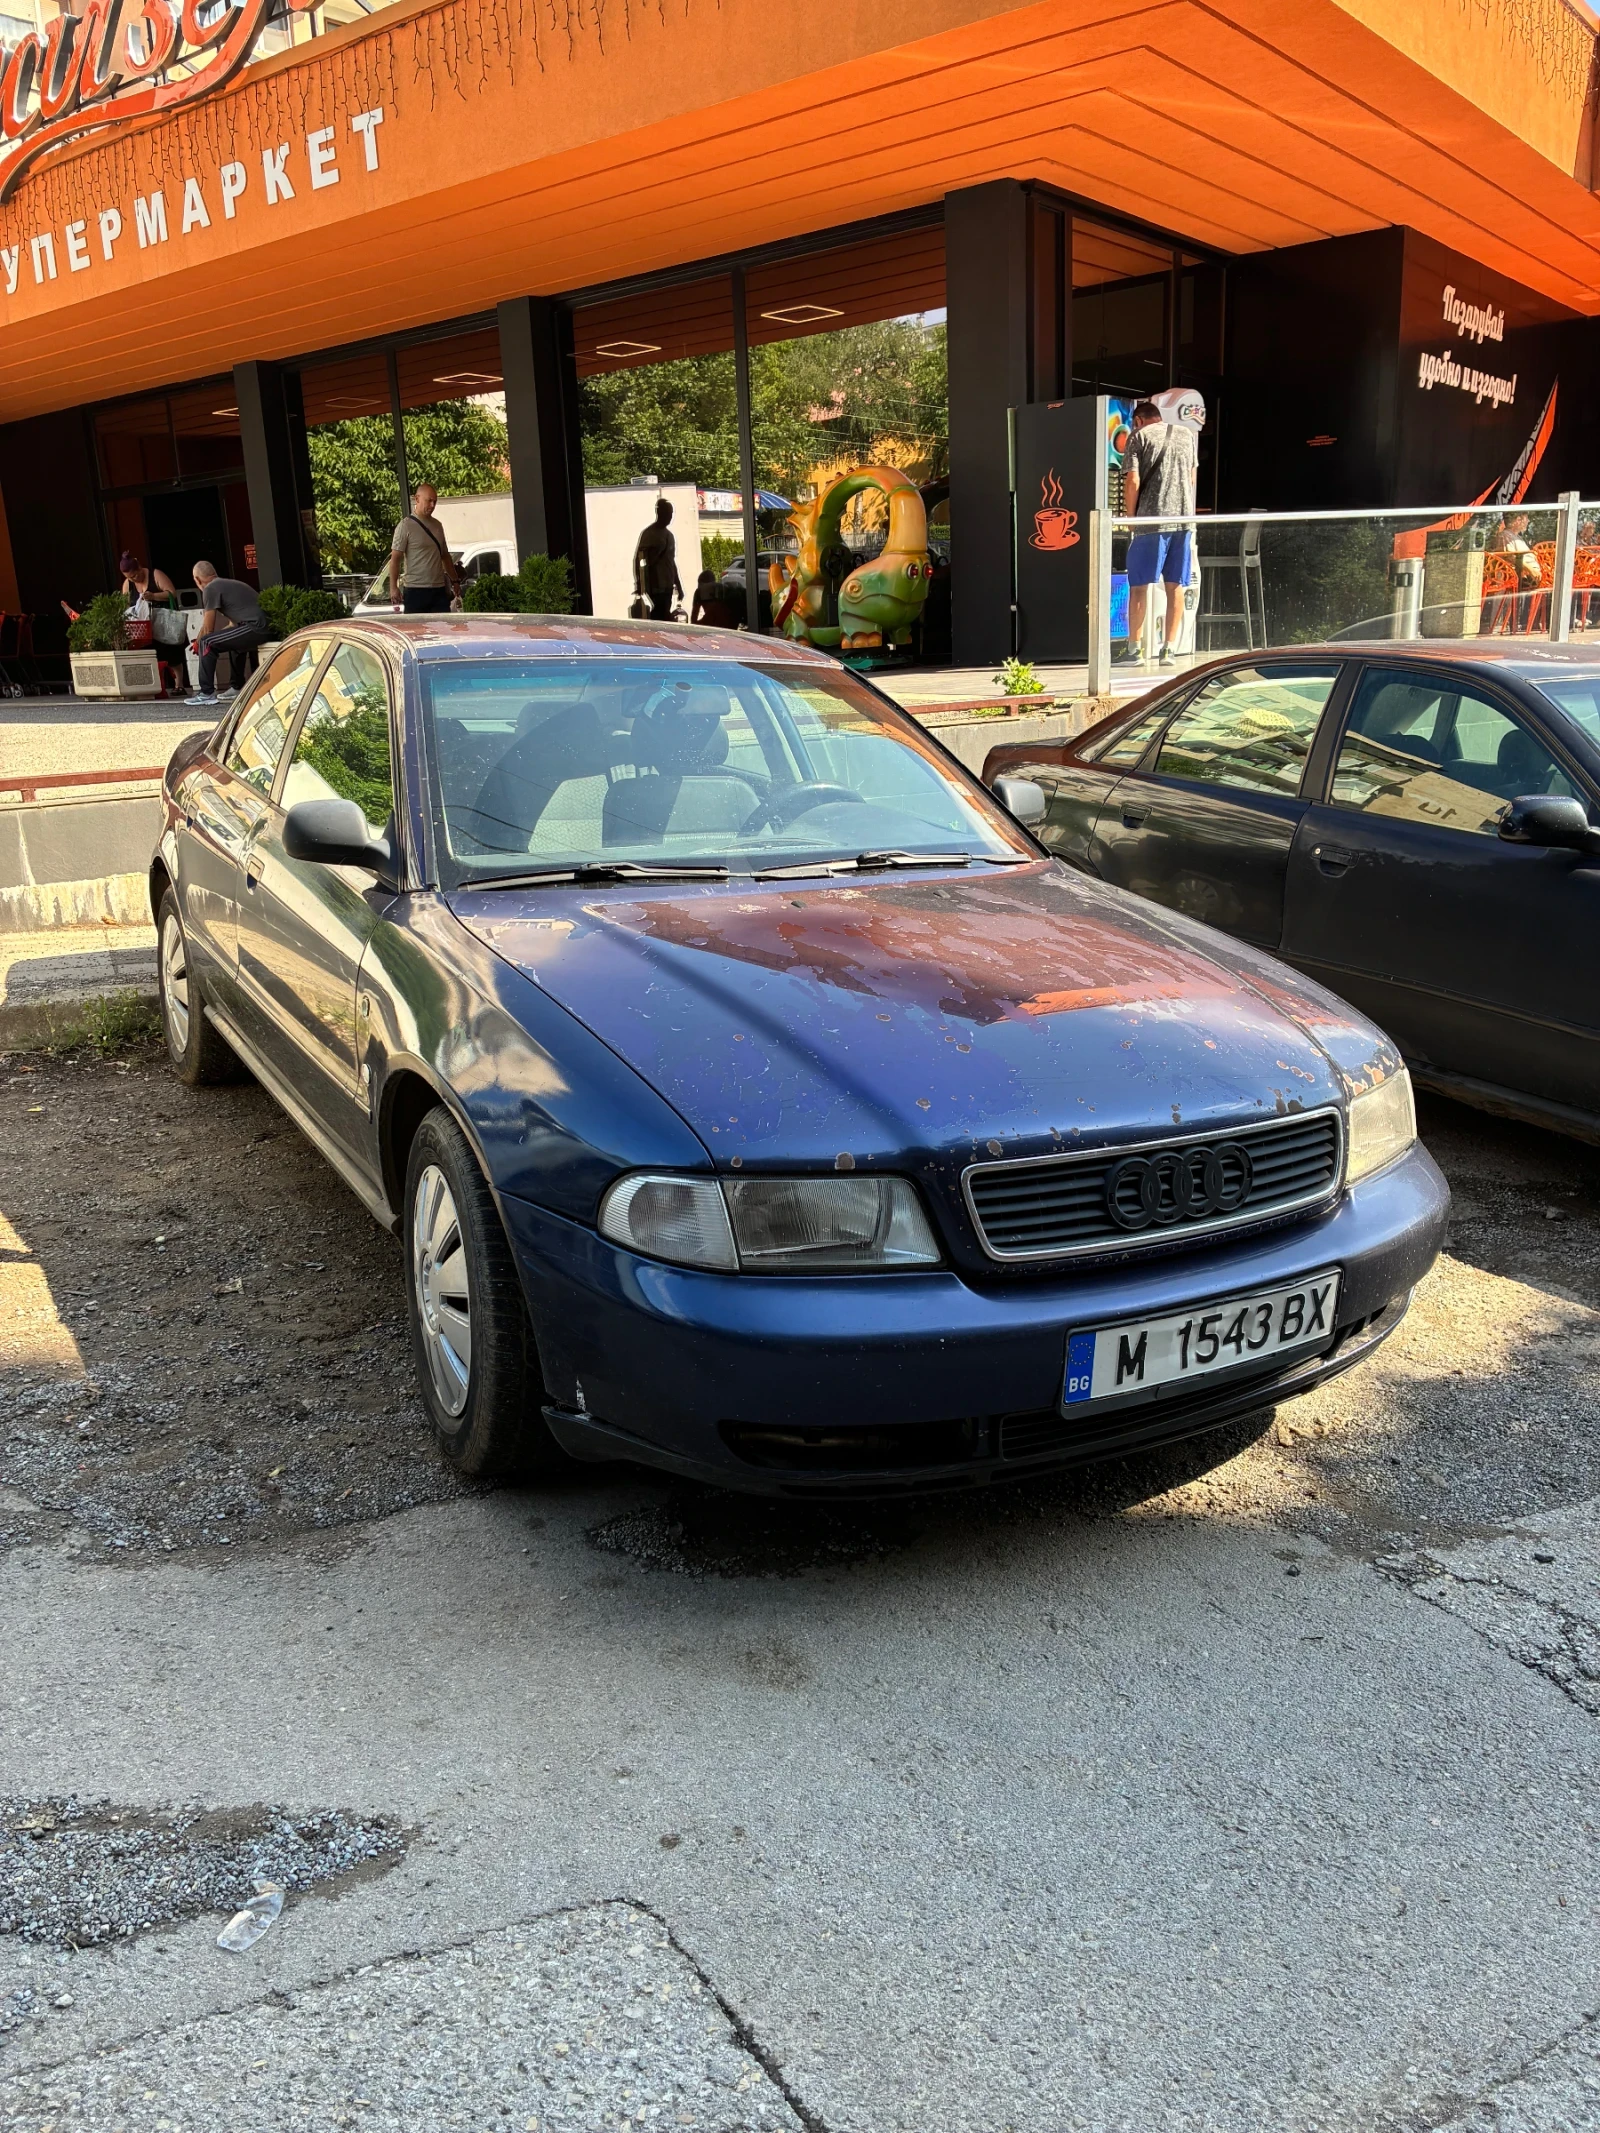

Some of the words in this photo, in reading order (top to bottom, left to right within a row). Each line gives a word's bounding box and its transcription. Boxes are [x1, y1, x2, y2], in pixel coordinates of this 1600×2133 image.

[1442, 284, 1505, 344] Пазарувай
[1418, 350, 1461, 390] удобно
[1461, 366, 1471, 391] и
[1470, 369, 1518, 409] изгодно!
[1068, 1375, 1090, 1393] BG
[1115, 1330, 1148, 1386] M
